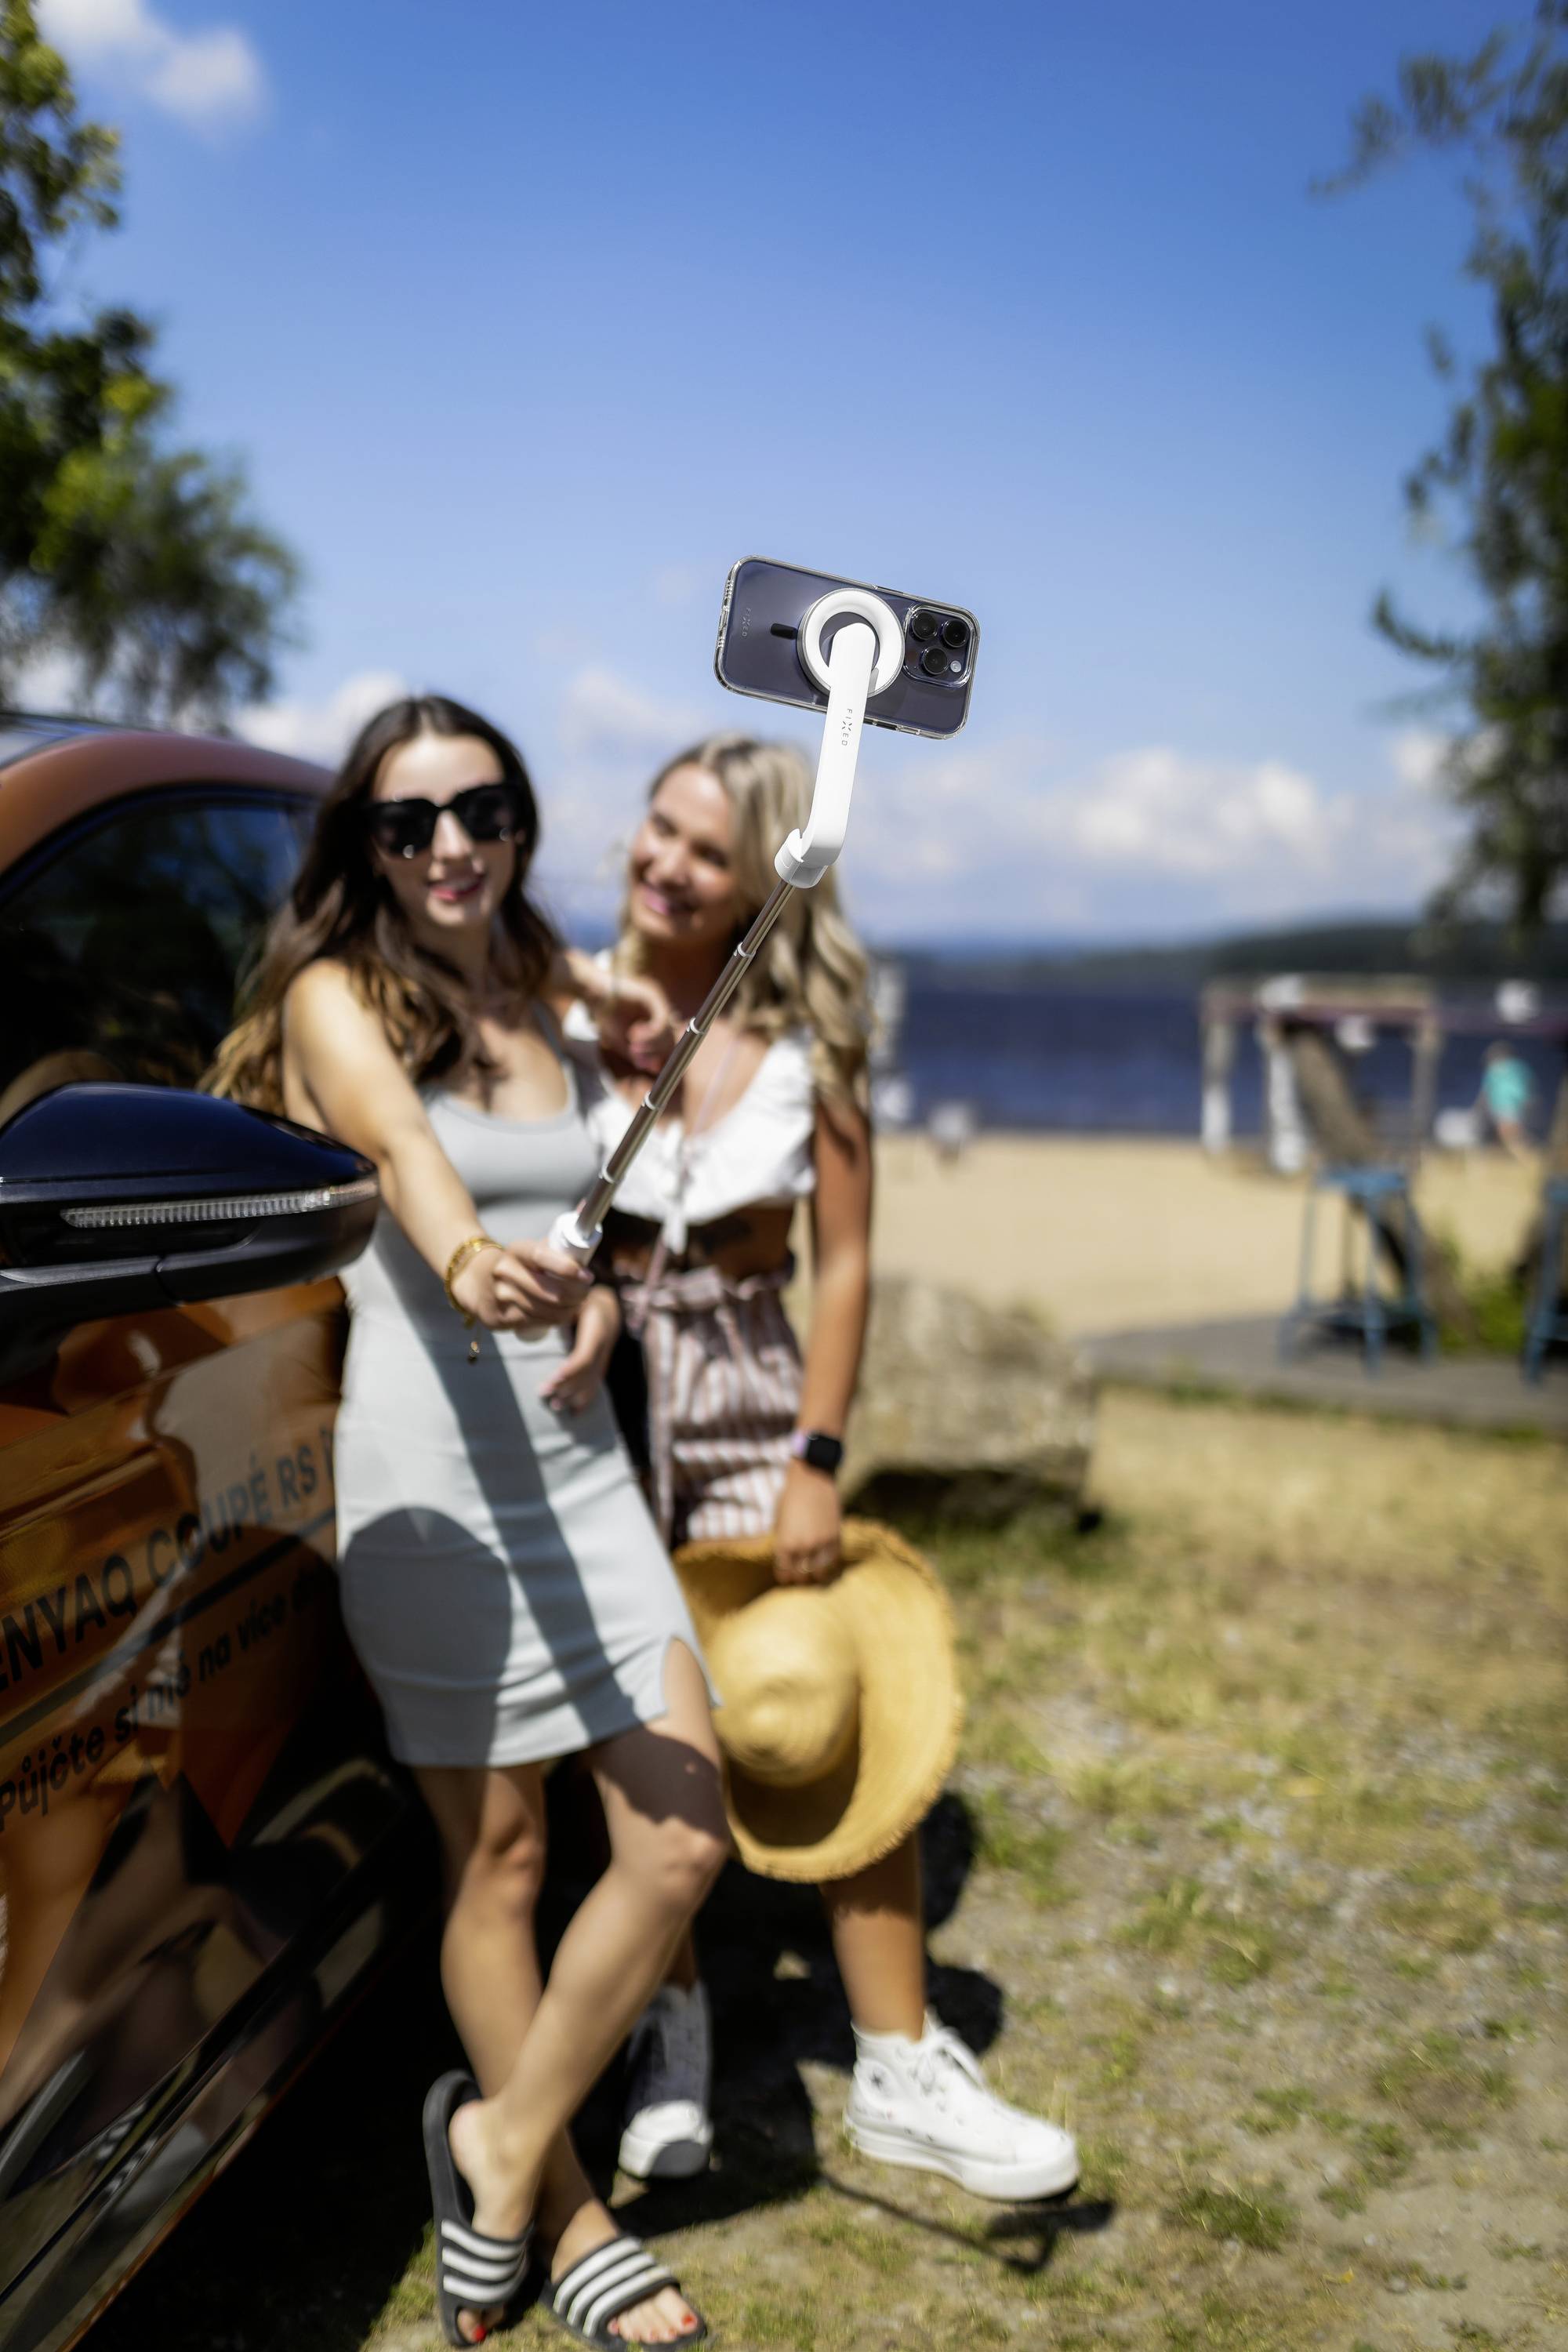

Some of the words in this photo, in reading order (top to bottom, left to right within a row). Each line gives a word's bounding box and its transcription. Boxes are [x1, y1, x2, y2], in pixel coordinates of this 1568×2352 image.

[741, 607, 751, 637] FIXED
[841, 708, 853, 746] FIXED
[147, 1453, 272, 1587] COUPÉ
[275, 1443, 318, 1508] RS
[114, 1684, 140, 1743] si
[199, 1633, 230, 1682] na
